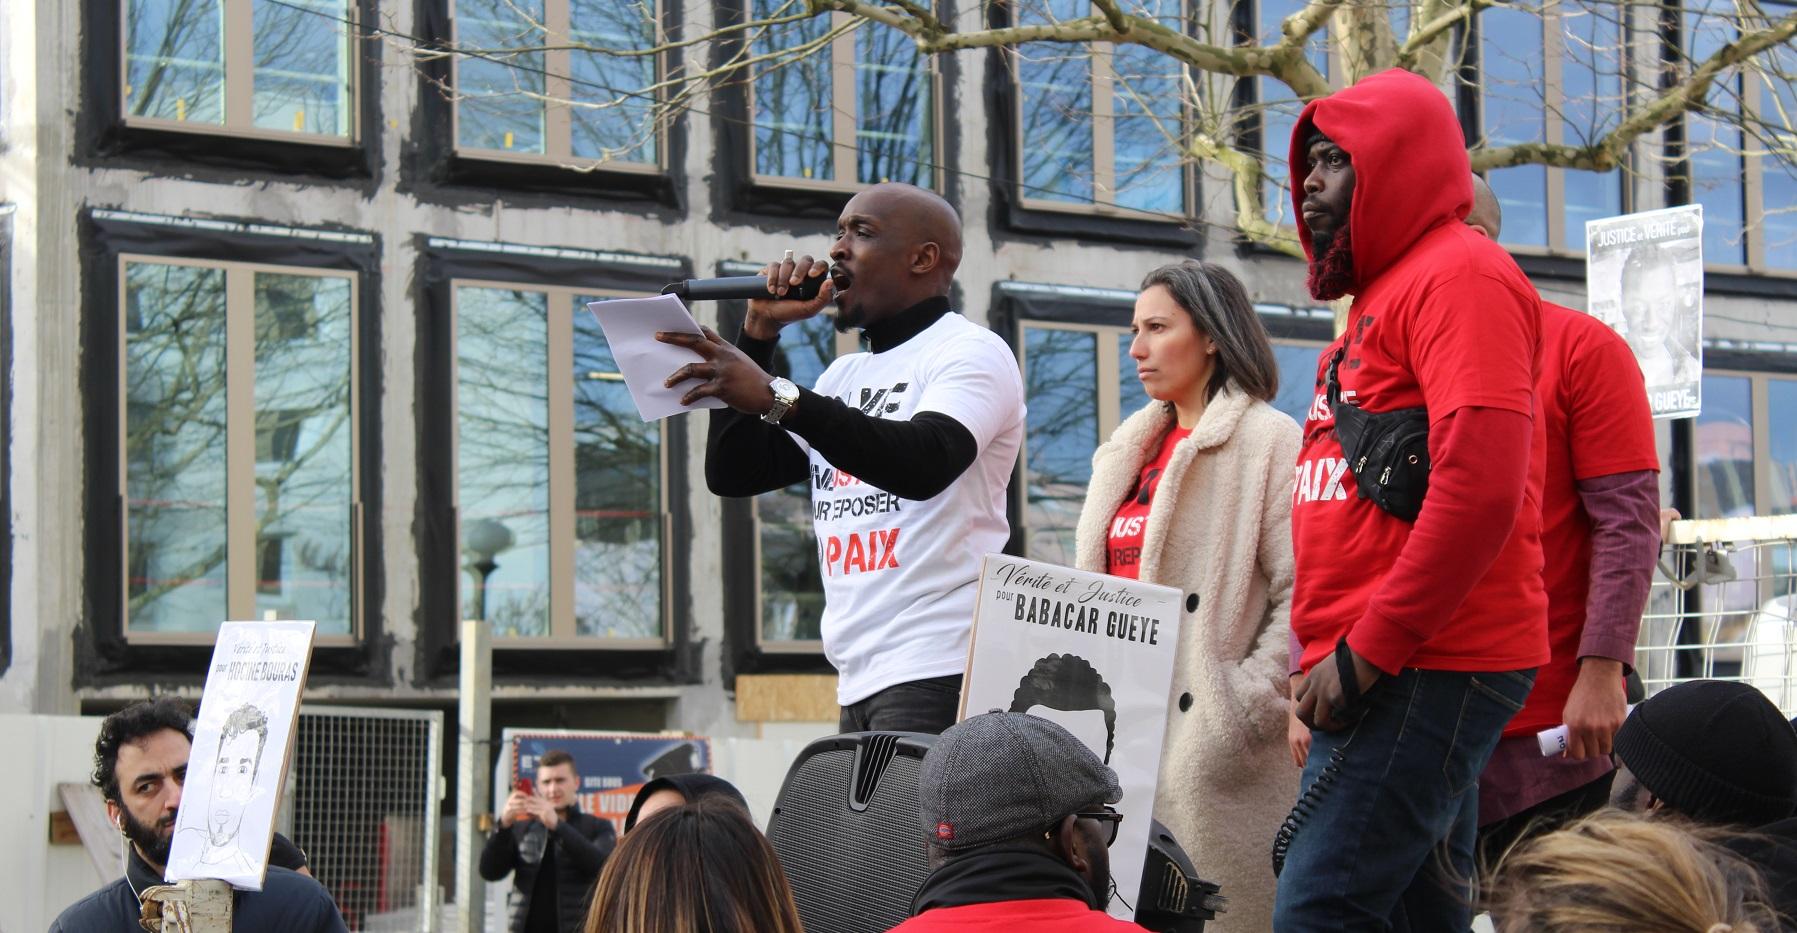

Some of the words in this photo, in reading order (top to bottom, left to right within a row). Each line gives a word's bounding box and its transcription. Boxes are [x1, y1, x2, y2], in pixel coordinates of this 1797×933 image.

[1598, 226, 1637, 248] JUSTICE
[1654, 389, 1692, 412] GUEYE
[826, 527, 901, 576] PAIX
[997, 563, 1052, 590] Vérité
[1054, 577, 1079, 594] et
[1078, 580, 1143, 608] Justice
[996, 589, 1014, 600] pour
[1014, 593, 1099, 635] BABACAR
[1106, 610, 1160, 646] GUEYE
[227, 661, 261, 681] HOCINE
[261, 661, 298, 682] BOURAS
